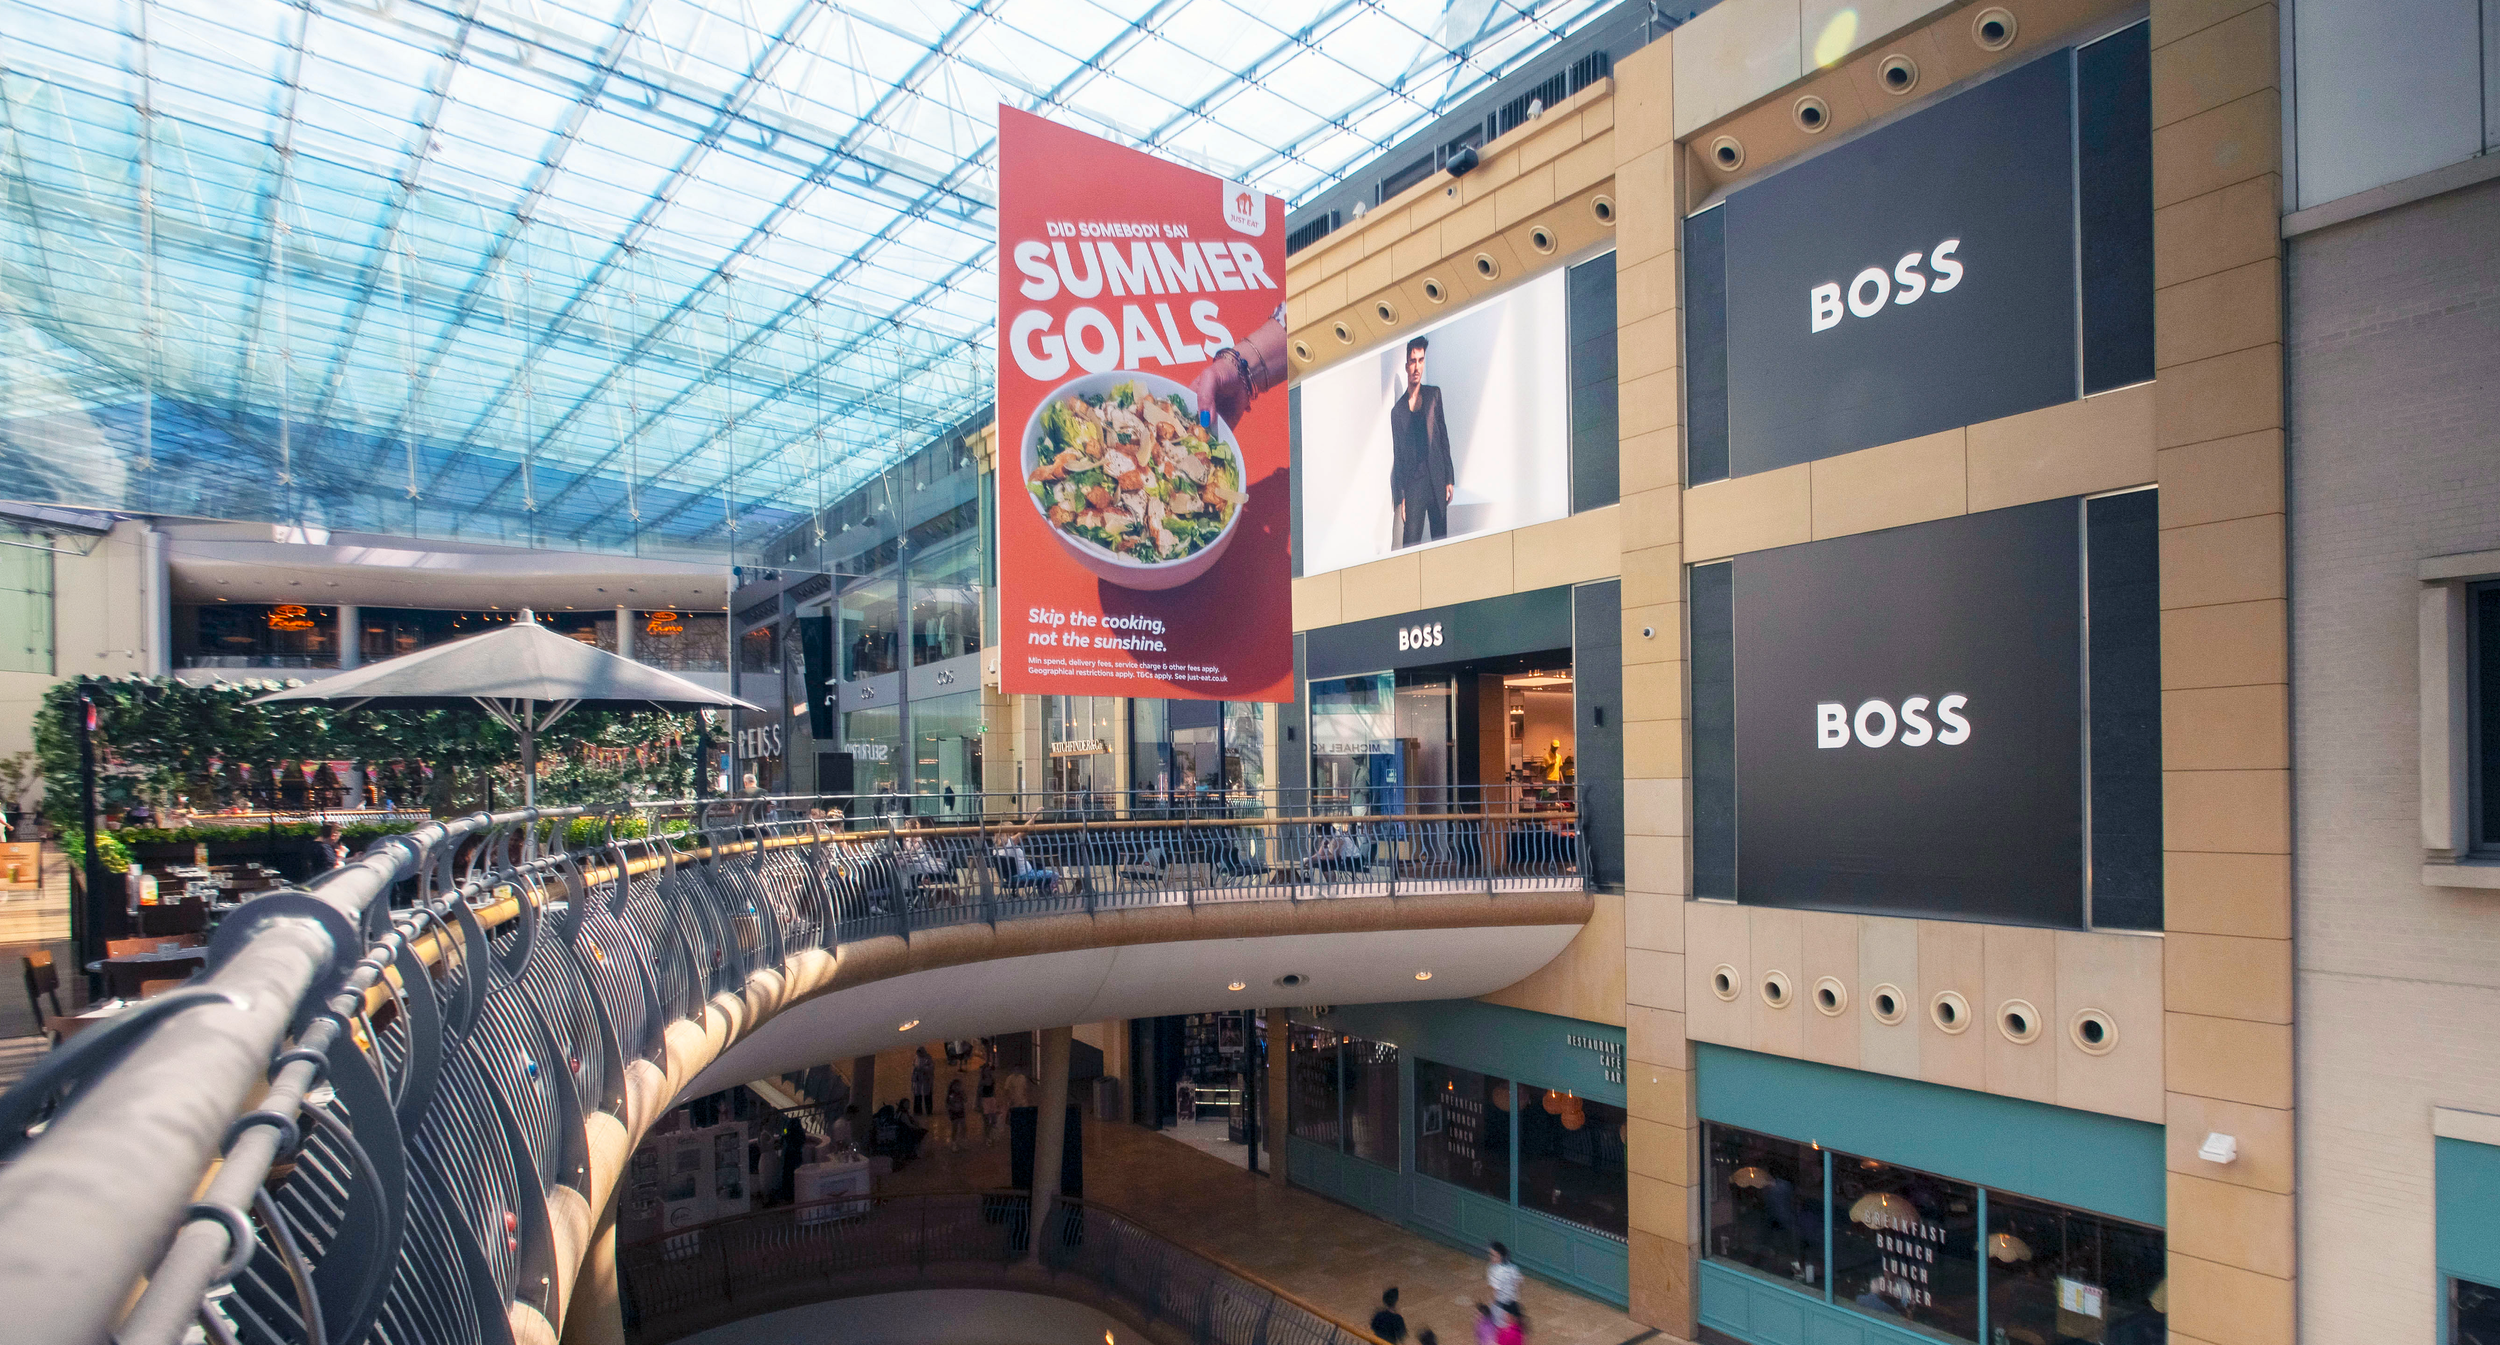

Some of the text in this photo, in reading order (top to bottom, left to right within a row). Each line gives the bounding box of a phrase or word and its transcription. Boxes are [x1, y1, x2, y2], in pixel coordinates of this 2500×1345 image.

[1046, 221, 1189, 239] DID SOMEBODY SAY
[1230, 213, 1259, 229] JUST EAT
[1014, 241, 1278, 301] SUMMER
[1811, 239, 1964, 334] BOSS
[1009, 300, 1235, 381] GOALS
[1028, 608, 1166, 635] Skip the cooking,
[1028, 631, 1167, 652] not the sunshine.
[1399, 622, 1444, 651] BOSS
[1028, 657, 1042, 665] Min
[1043, 657, 1067, 667] spend,
[1069, 658, 1096, 668] delivery
[1097, 660, 1114, 669] fees,
[1115, 661, 1138, 669] service
[1139, 662, 1161, 672] charge
[1187, 665, 1200, 673] fees
[1201, 666, 1220, 674] apply.
[1028, 666, 1229, 683] Geographical restrictions apply. T&Cs apply. See just-eat.co.uk
[1817, 694, 1971, 749] BOSS
[738, 724, 780, 759] REISS
[1567, 1034, 1621, 1055] RESTAURANT
[1605, 1069, 1621, 1083] BAR
[1864, 1209, 1946, 1245] BREAKFAST
[1876, 1232, 1933, 1263] BRUNCH
[1882, 1256, 1928, 1284] LUNCH
[1879, 1279, 1932, 1307] DINNER
